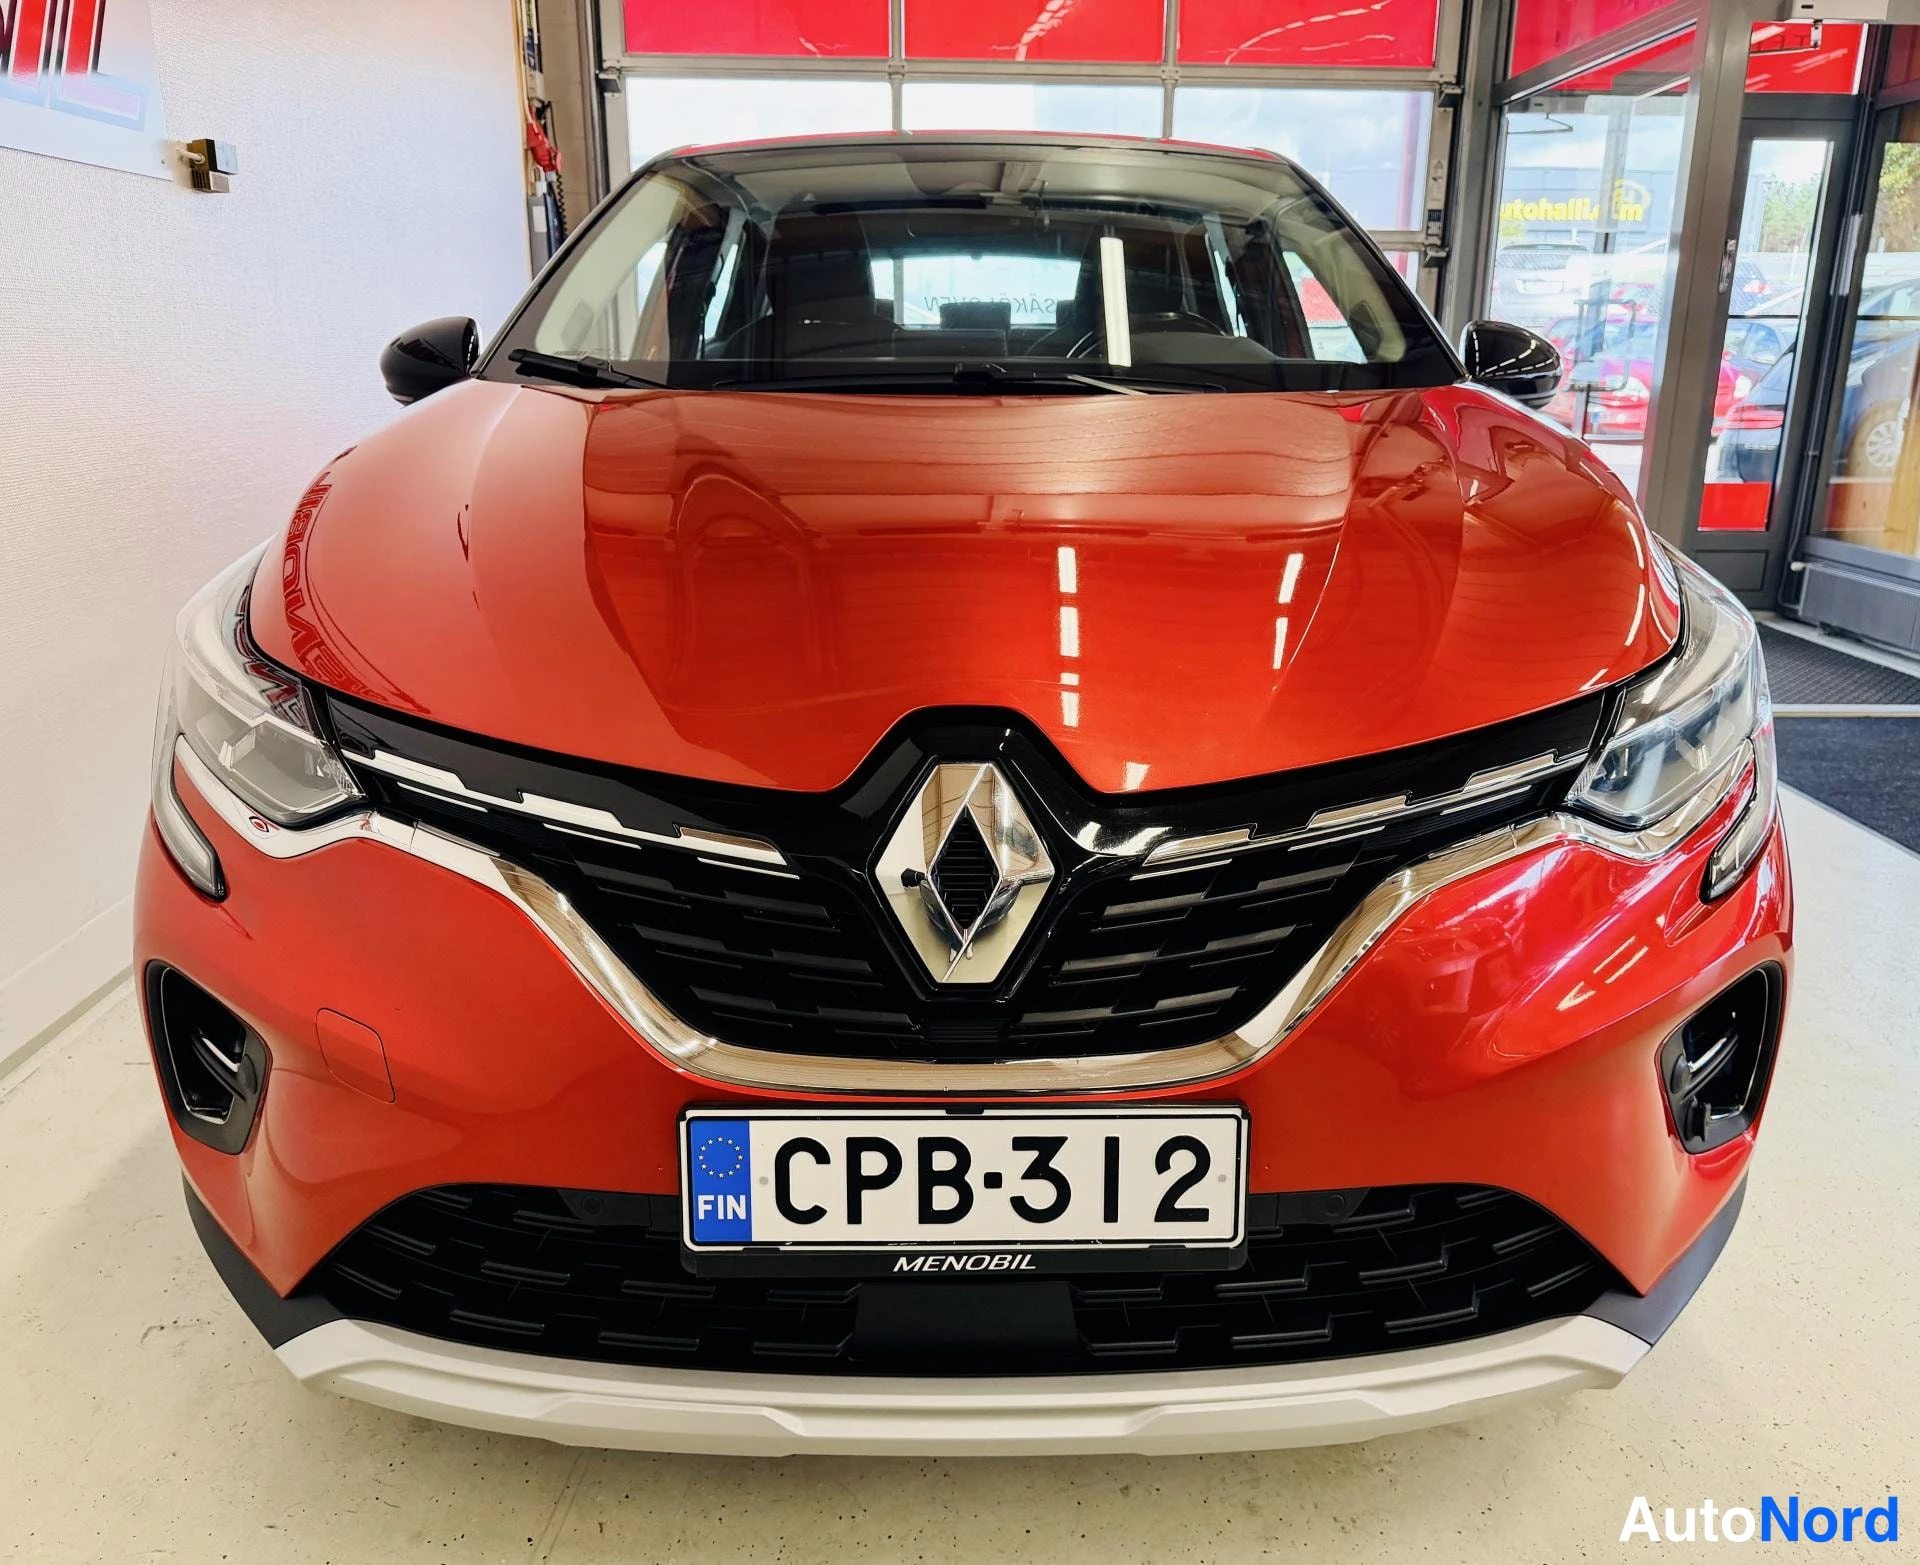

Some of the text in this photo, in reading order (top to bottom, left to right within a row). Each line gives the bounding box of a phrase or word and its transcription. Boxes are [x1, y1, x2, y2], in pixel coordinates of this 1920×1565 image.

[697, 1135, 1212, 1226] FIN CPB-312
[893, 1253, 1037, 1273] MENOBIL
